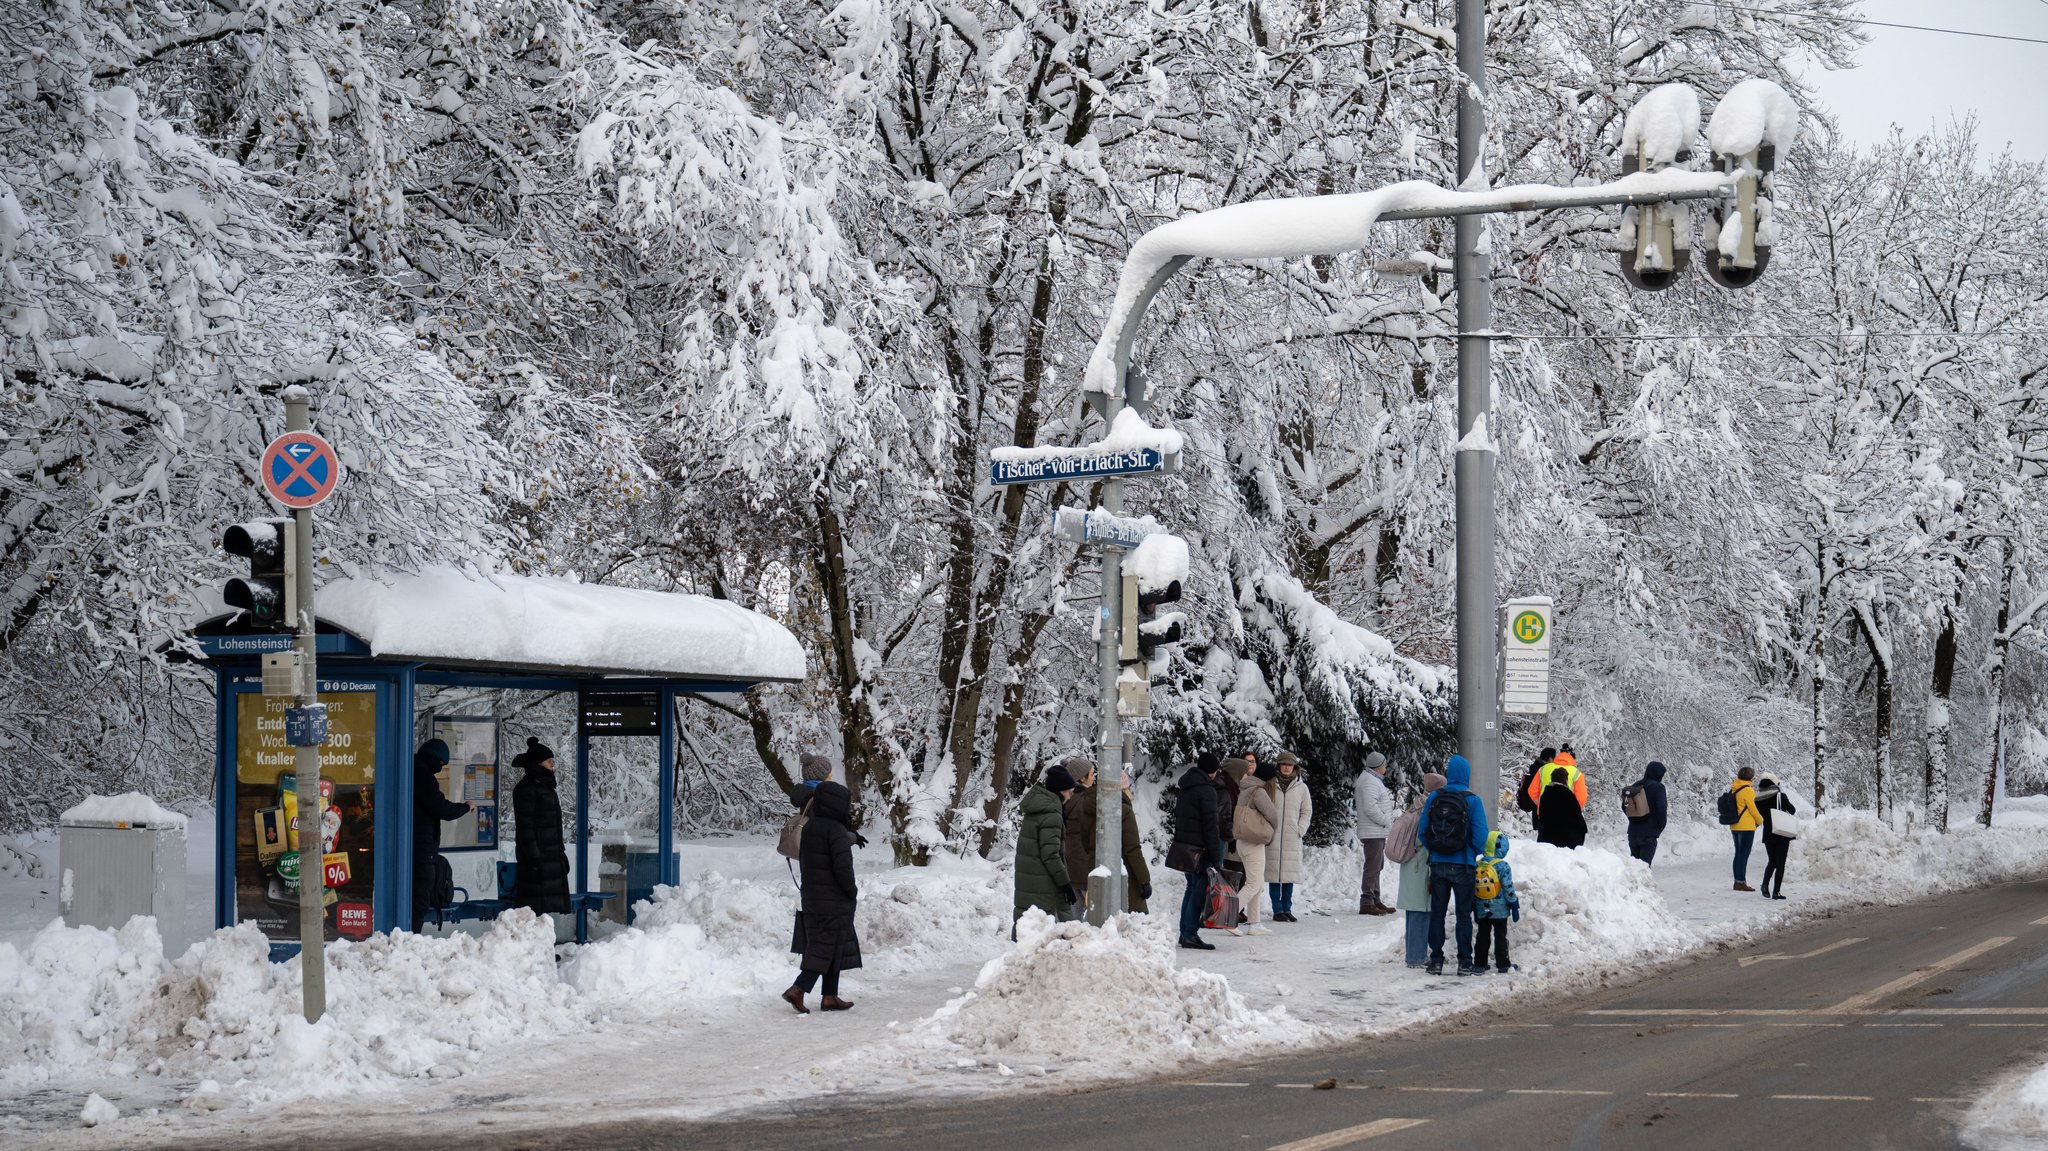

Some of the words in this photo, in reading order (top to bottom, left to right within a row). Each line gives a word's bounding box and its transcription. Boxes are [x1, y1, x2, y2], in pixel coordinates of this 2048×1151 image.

[998, 450, 1151, 479] Fischer-von-Erlach-Str.
[1091, 523, 1144, 543] Agnes-Bernau
[349, 682, 376, 690] Decaux
[327, 734, 351, 748] 300
[341, 909, 367, 919] REWE
